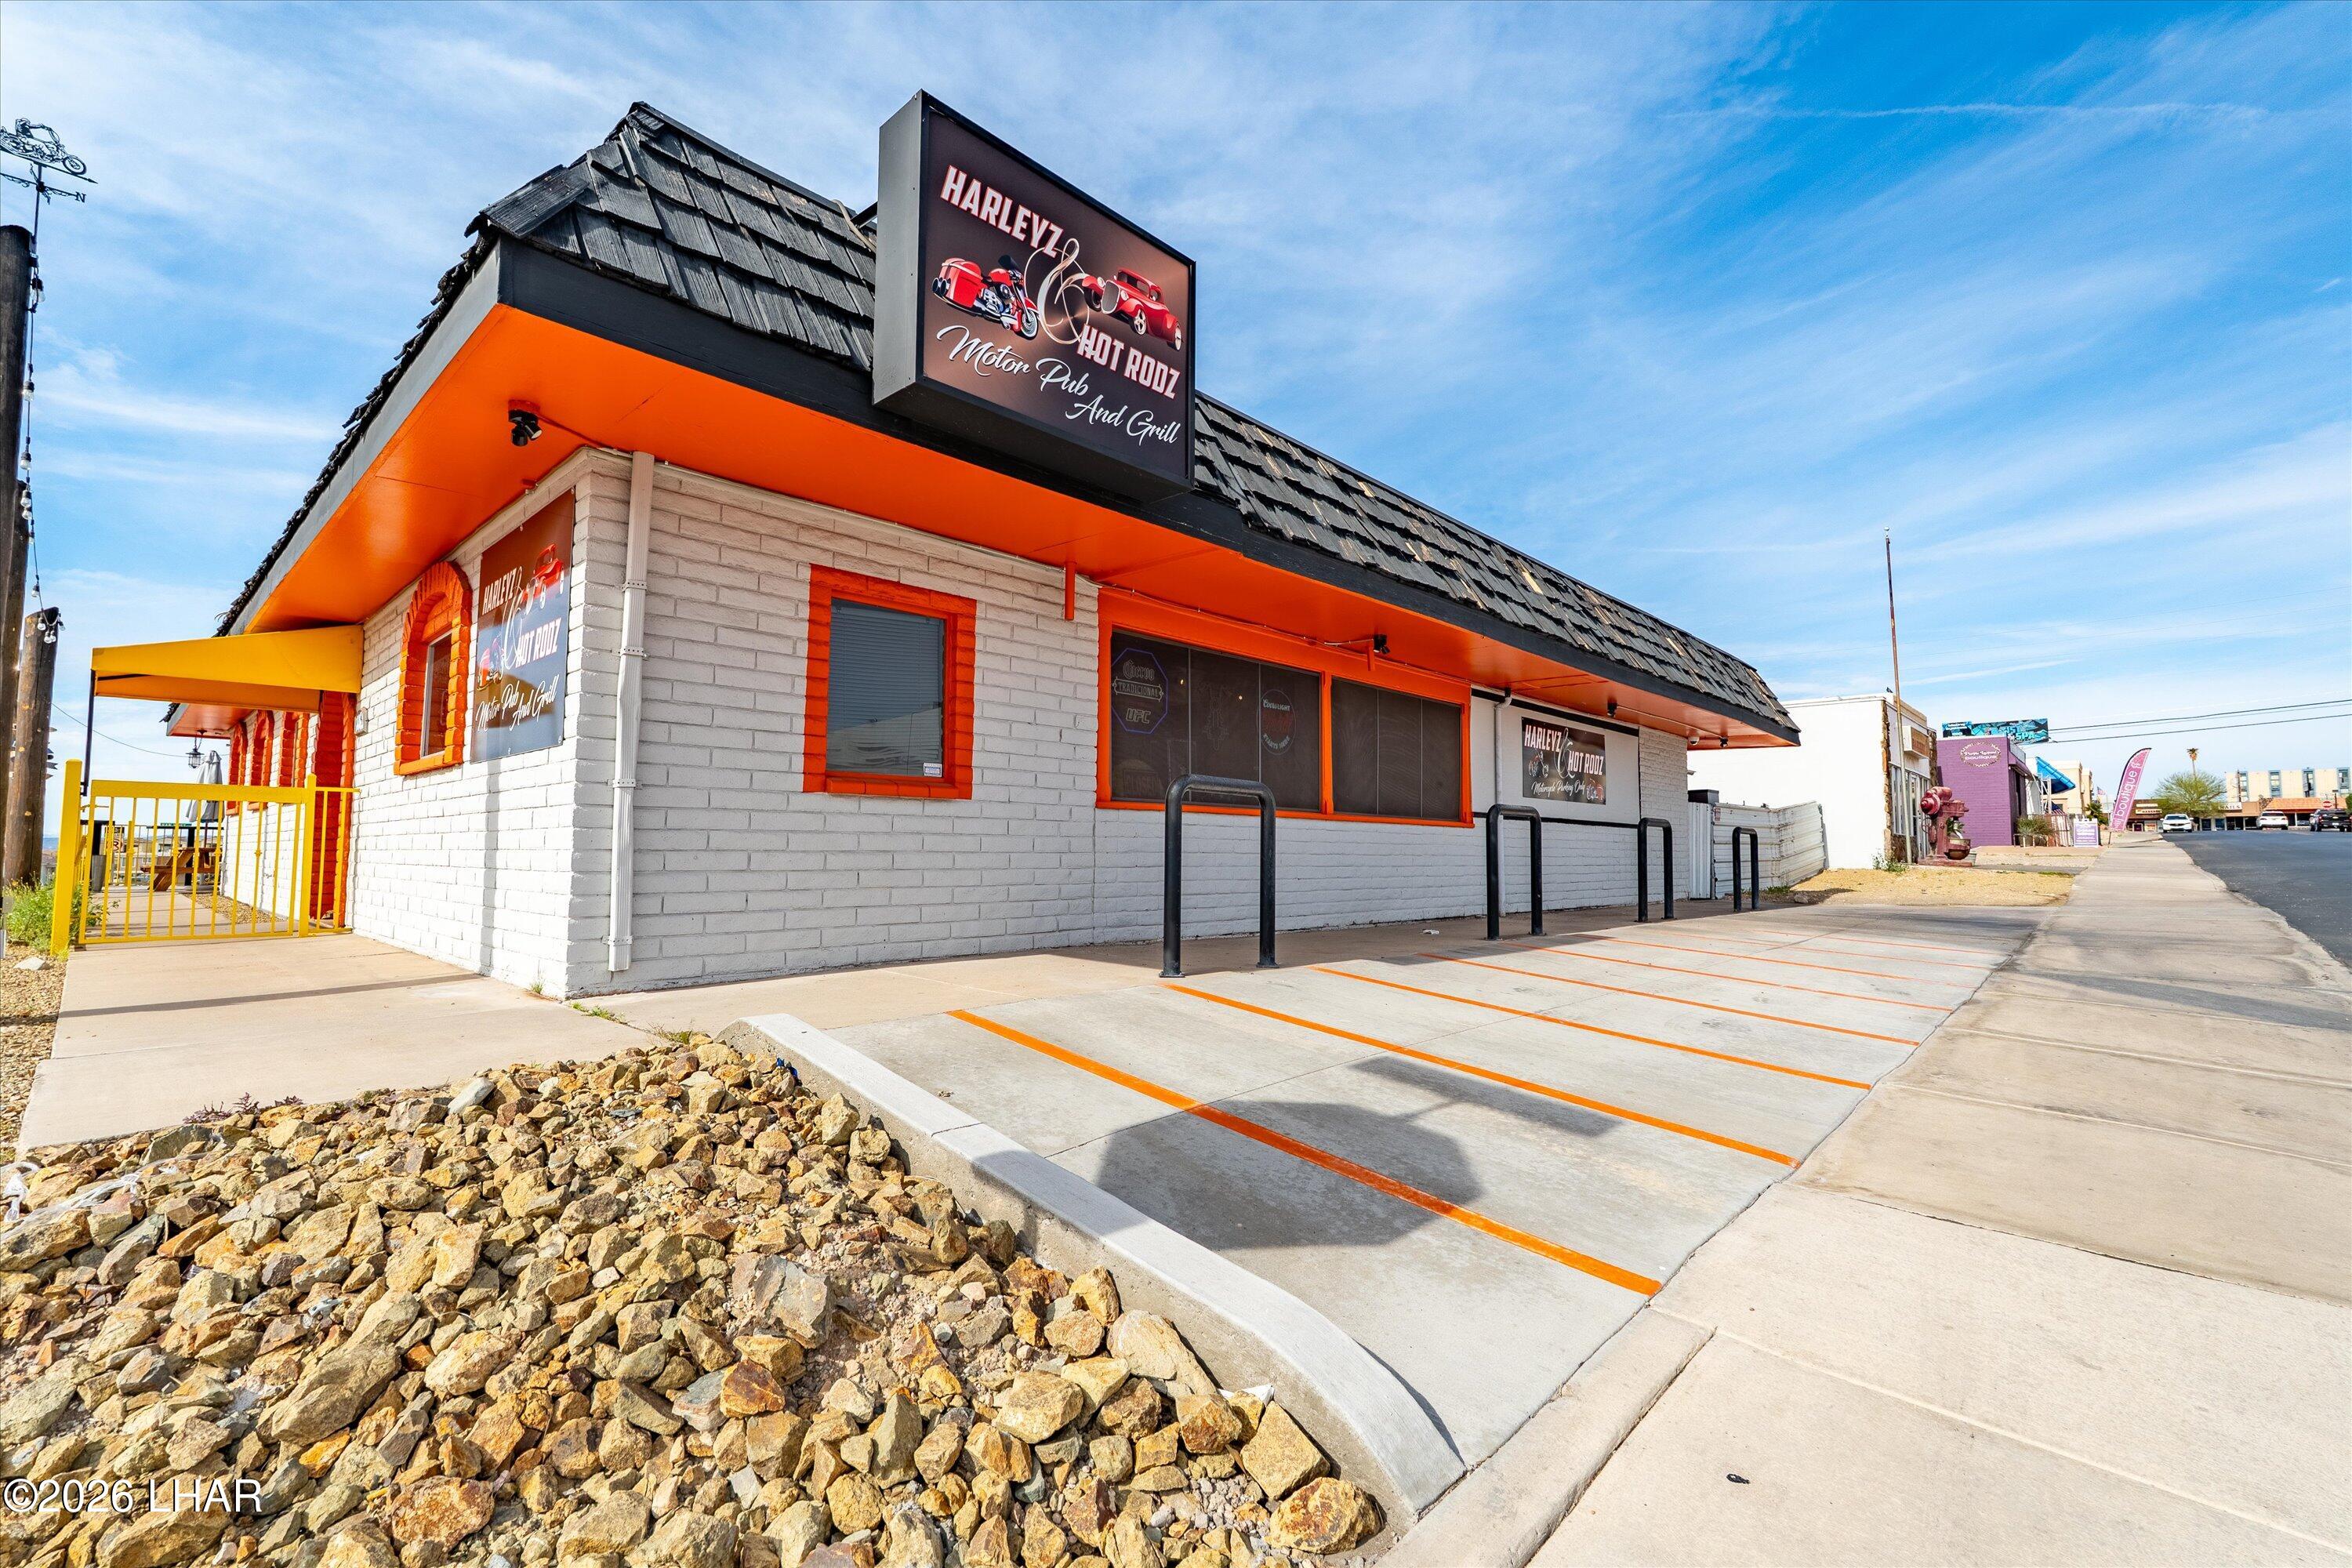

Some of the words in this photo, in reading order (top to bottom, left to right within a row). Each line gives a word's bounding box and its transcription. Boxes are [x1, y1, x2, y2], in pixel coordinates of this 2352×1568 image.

[74, 191, 86, 203] N
[941, 165, 1064, 258] HARLEYZ
[936, 325, 1030, 376] Motor
[1035, 358, 1089, 396] Pub
[1077, 323, 1124, 372] HOT
[1123, 346, 1180, 399] RODZ
[1065, 394, 1128, 426] And
[1127, 410, 1181, 446] Grill
[482, 568, 517, 615] HARLEYZ
[515, 630, 535, 669] HOT
[533, 618, 562, 661] RODZ
[475, 696, 500, 731] Motor
[502, 680, 520, 720] Pub
[510, 689, 534, 731] And
[532, 673, 559, 722] Grill
[1118, 681, 1159, 698] TRADICIONAL
[1126, 707, 1152, 724] UFC
[1524, 724, 1563, 753] HARLEYZ
[1568, 750, 1584, 772] HOT
[1584, 753, 1604, 775] RODZ
[2115, 770, 2138, 816] boutique
